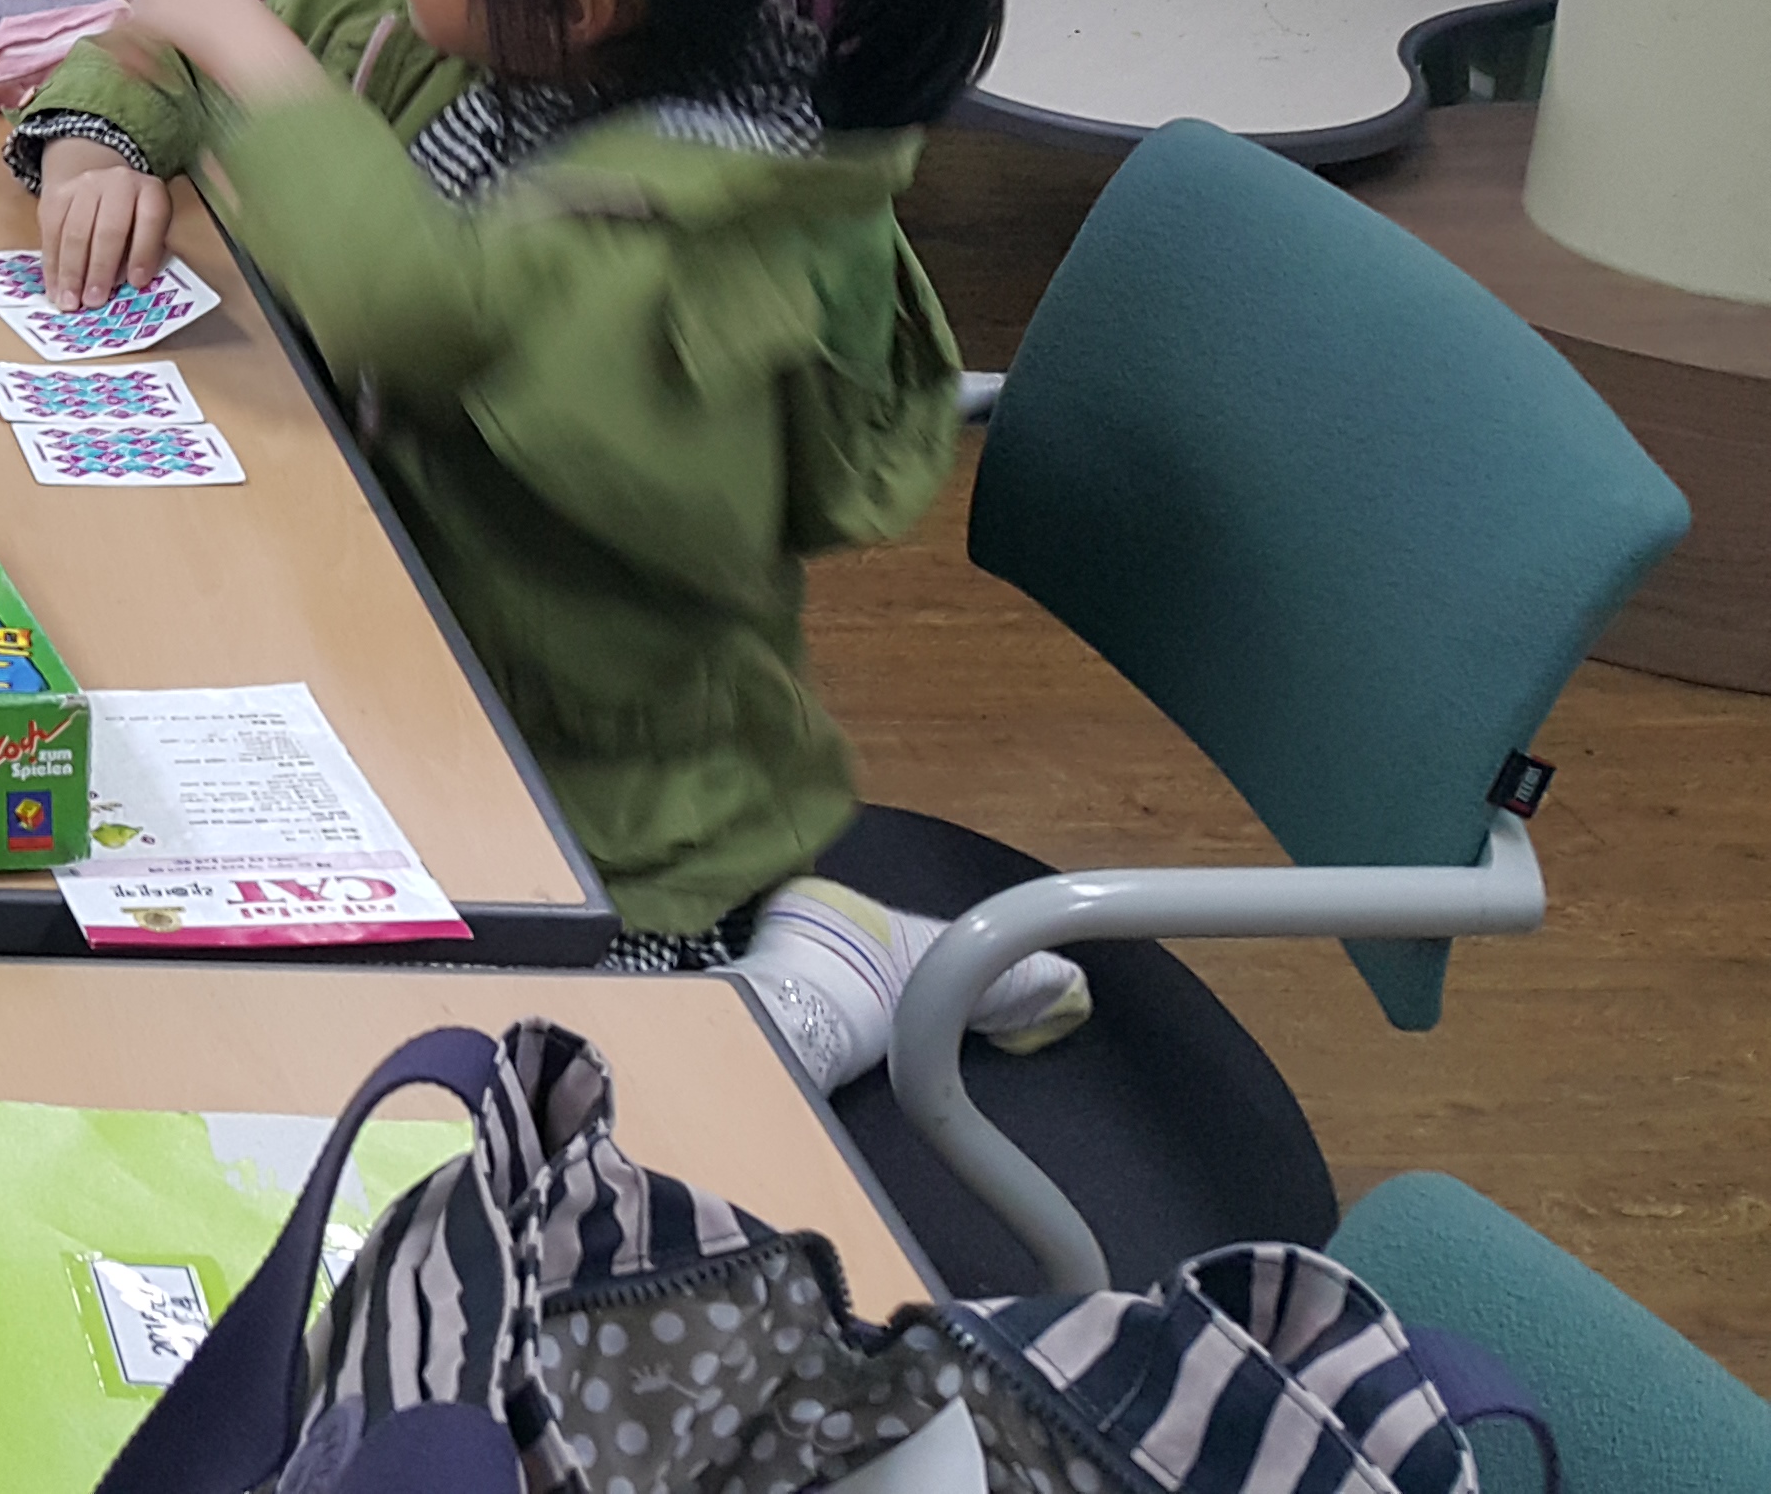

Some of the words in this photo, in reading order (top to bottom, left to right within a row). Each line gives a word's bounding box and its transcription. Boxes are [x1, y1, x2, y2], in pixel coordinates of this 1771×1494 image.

[37, 749, 73, 762] zum
[11, 762, 74, 781] Spielen
[227, 875, 397, 905] CAT
